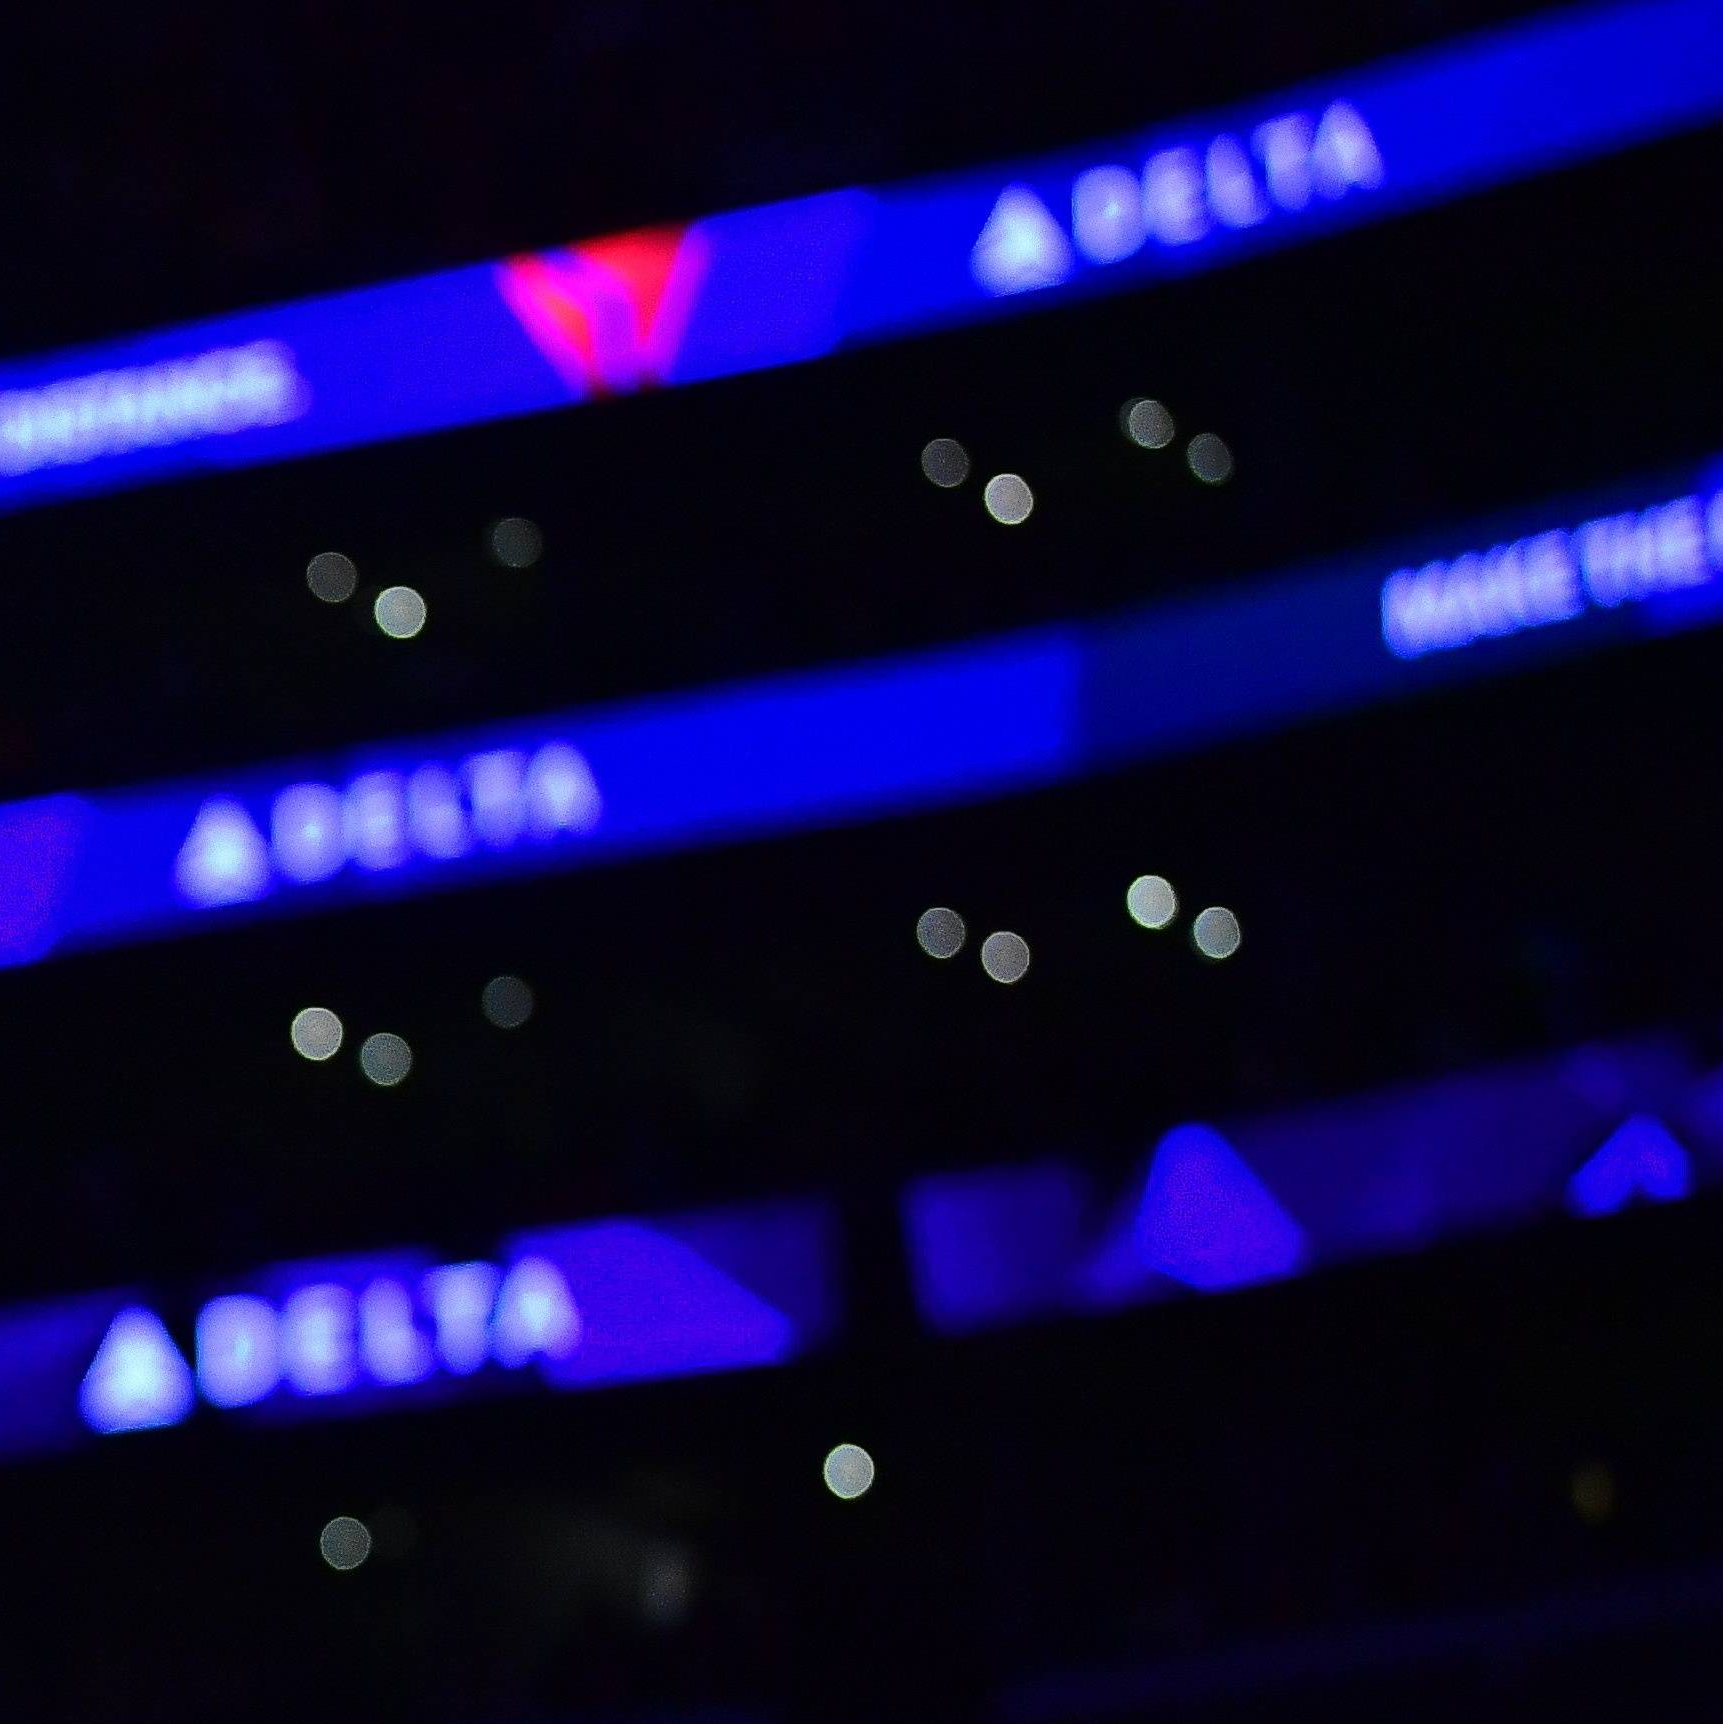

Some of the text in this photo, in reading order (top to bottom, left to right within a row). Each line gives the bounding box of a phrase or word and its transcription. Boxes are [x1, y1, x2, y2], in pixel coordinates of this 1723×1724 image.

[1072, 102, 1381, 264] DELTA
[1382, 528, 1581, 656] MAKE
[1578, 494, 1709, 608] THE
[270, 743, 601, 882] DELTA
[196, 1256, 583, 1408] DELTA
